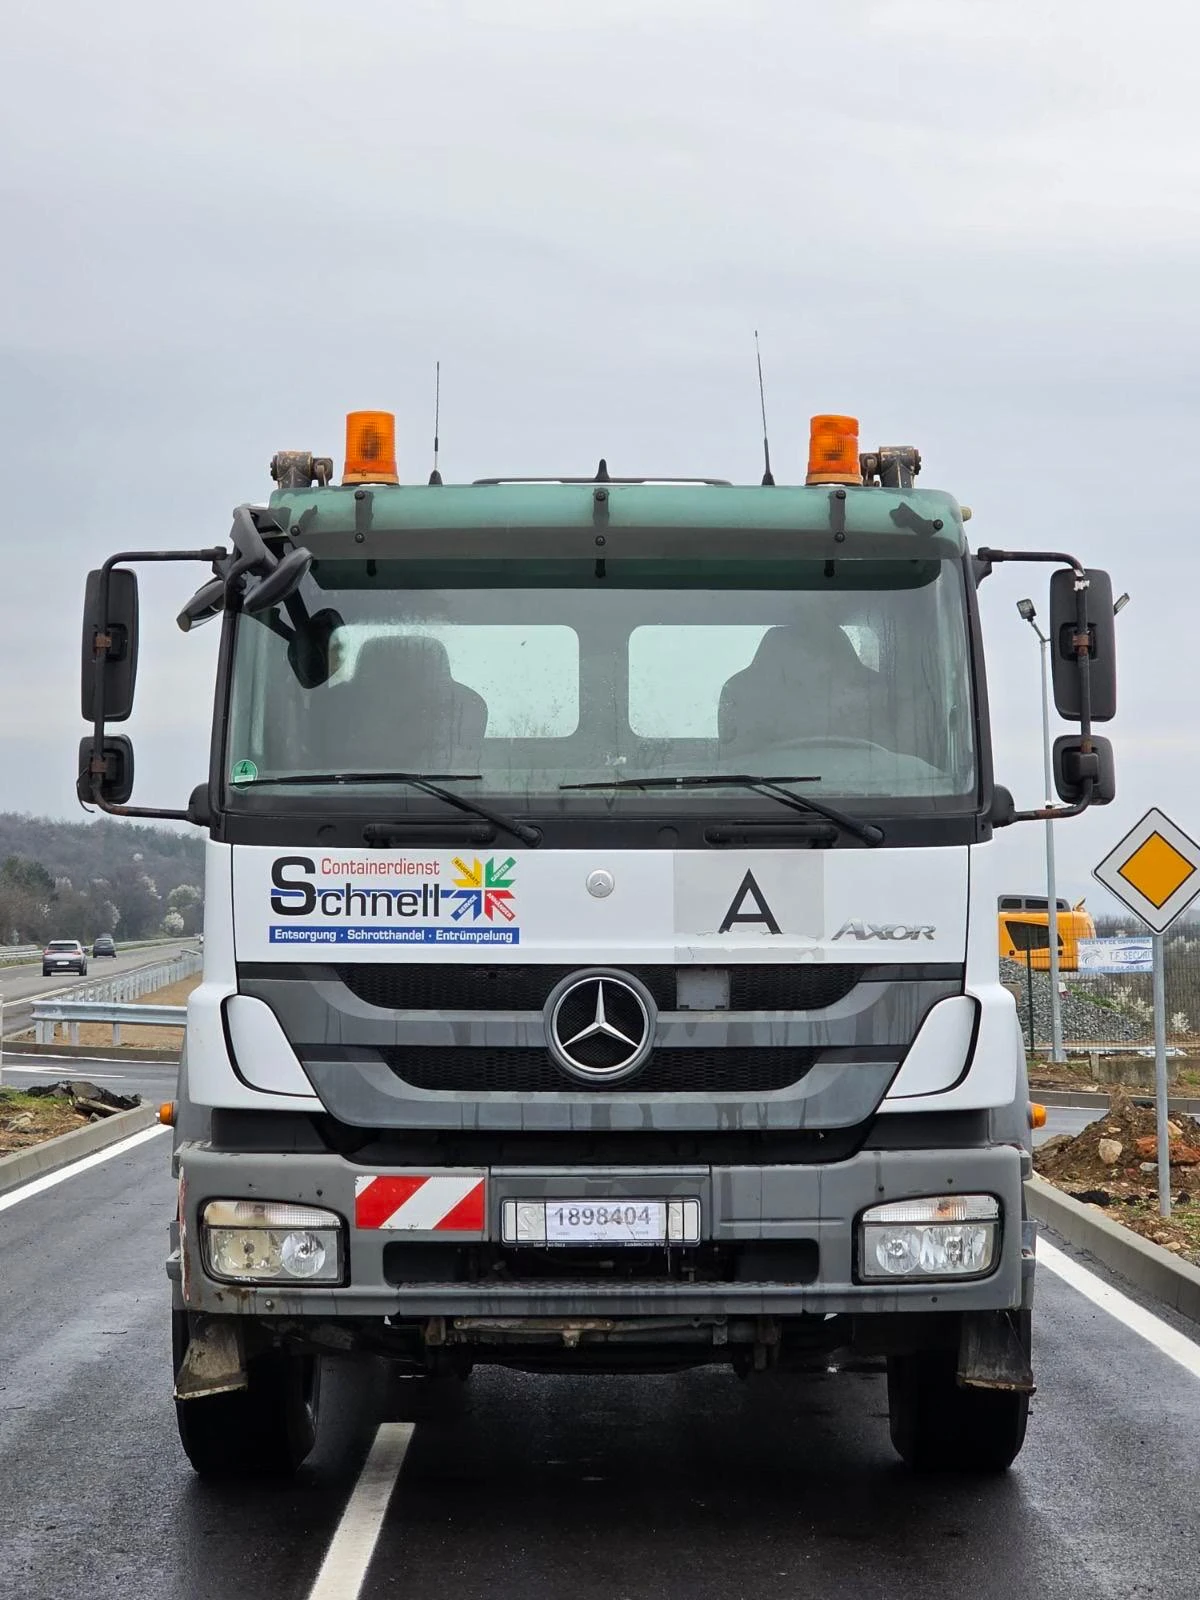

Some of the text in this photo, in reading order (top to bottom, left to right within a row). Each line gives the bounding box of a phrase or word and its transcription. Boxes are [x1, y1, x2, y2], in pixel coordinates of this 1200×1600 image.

[240, 762, 248, 775] 4
[322, 857, 440, 876] Containerdienst
[271, 856, 440, 917] Schnell
[457, 894, 478, 914] SERVICE
[718, 868, 784, 934] A
[275, 929, 513, 943] Entsorgung Schrotthandel Entrümpelung
[831, 918, 936, 941] AXOR
[554, 1206, 651, 1226] 1898404
